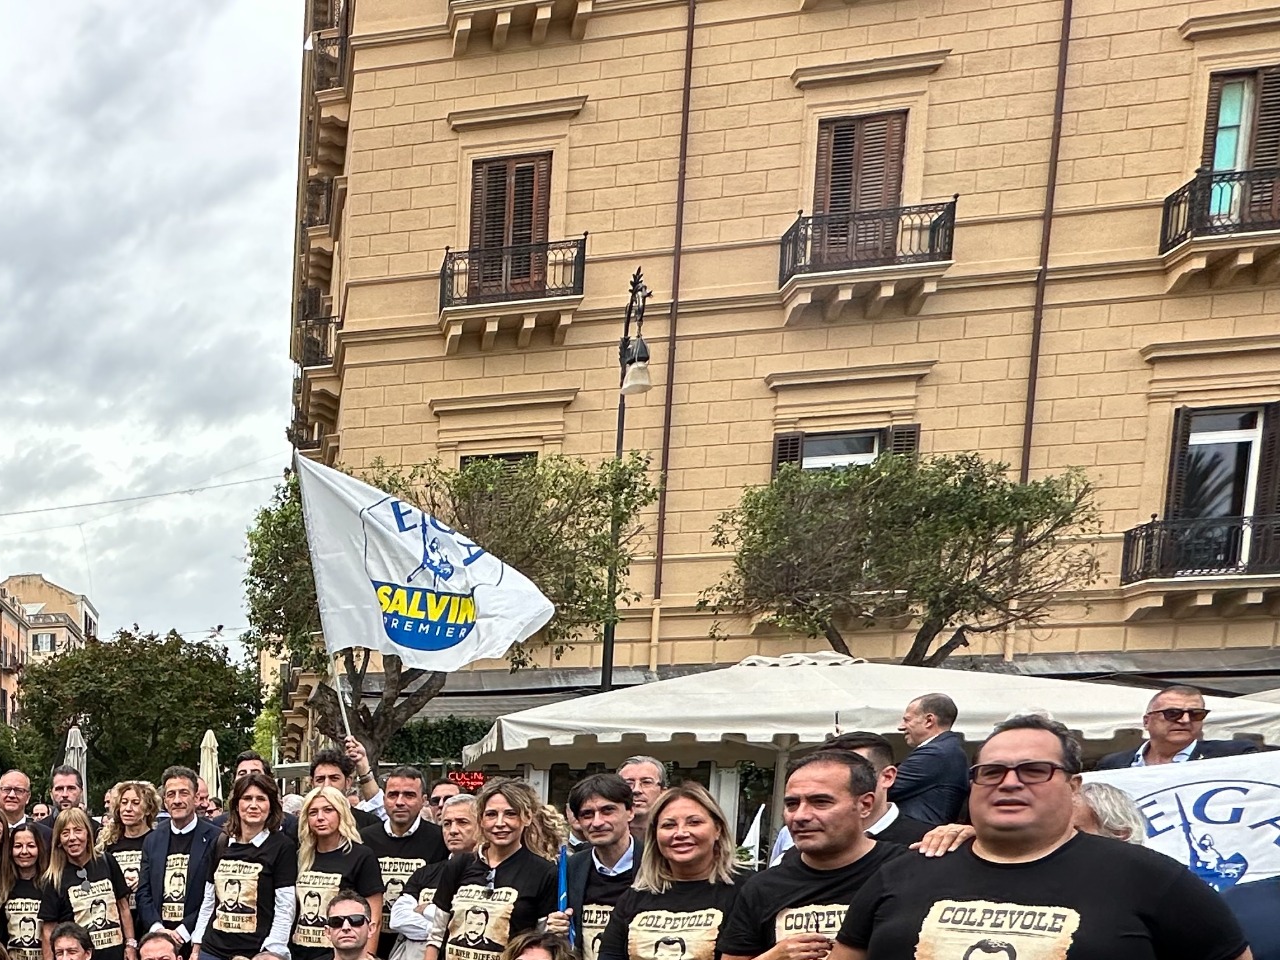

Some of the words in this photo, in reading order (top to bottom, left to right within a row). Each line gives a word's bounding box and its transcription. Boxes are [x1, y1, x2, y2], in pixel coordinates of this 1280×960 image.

[377, 585, 476, 625] SALVIN
[637, 913, 716, 930] COLPEVOLE
[938, 906, 1067, 933] COLPEVOLE
